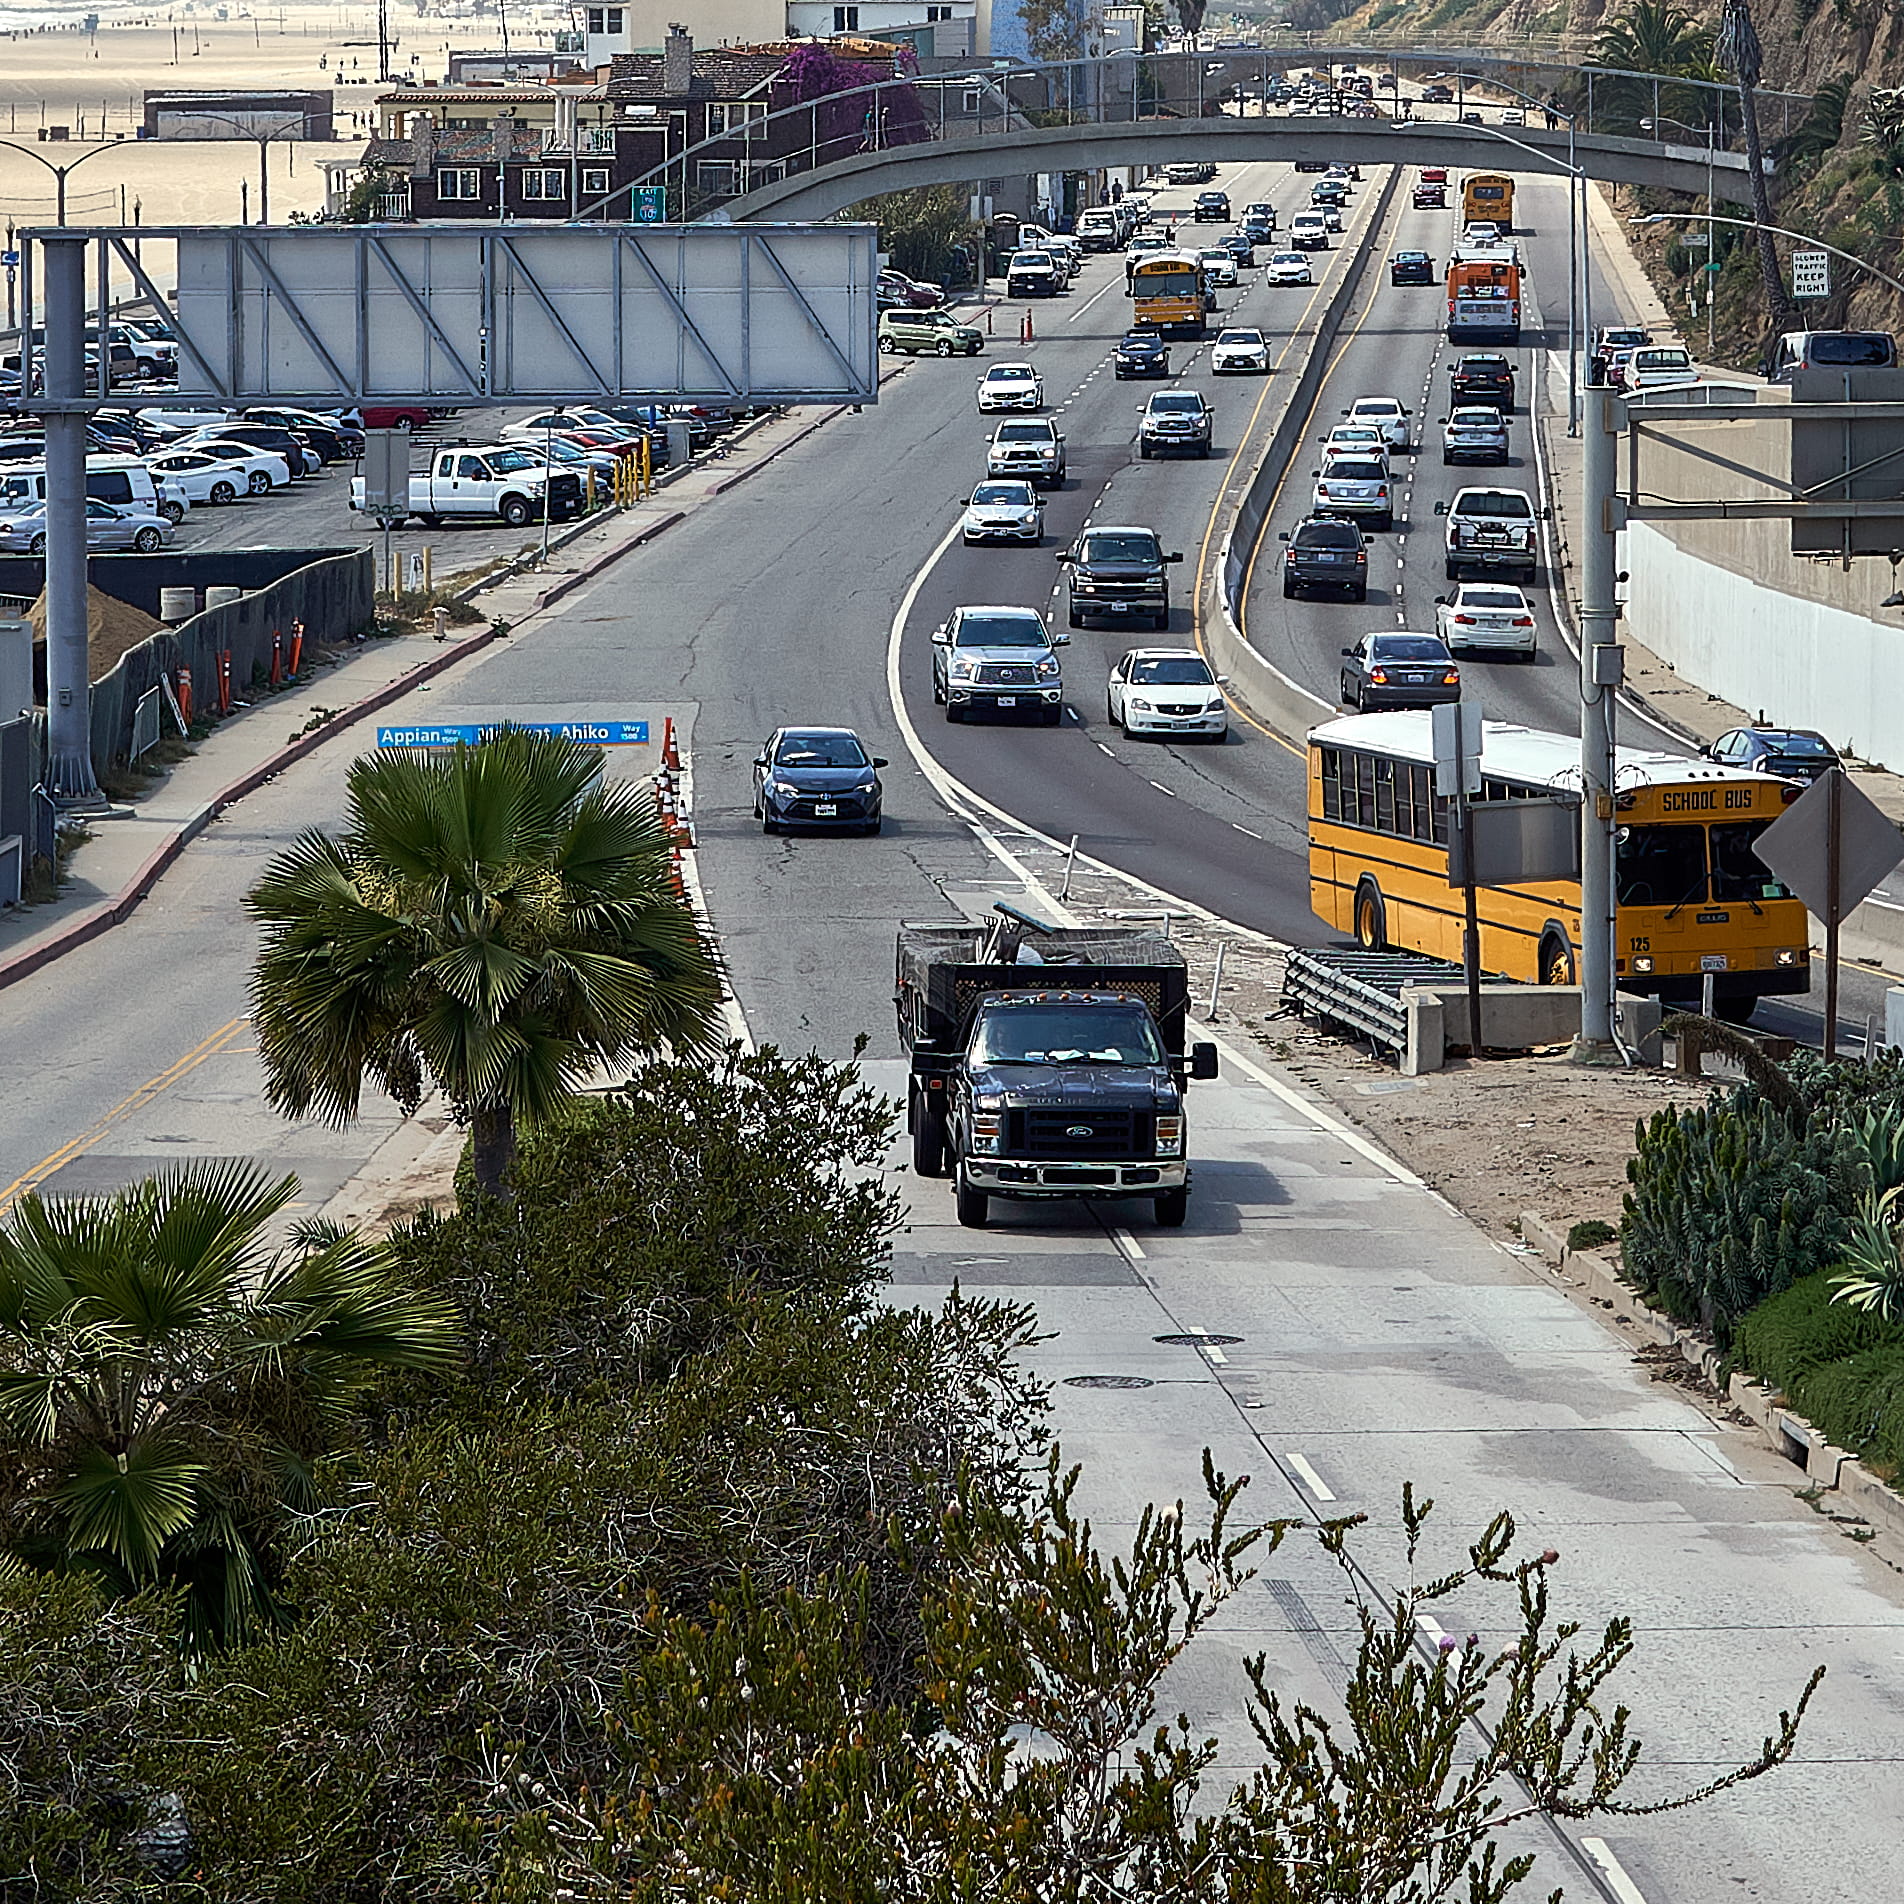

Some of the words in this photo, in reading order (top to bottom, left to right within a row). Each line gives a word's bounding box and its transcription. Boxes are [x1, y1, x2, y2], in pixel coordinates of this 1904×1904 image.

[1796, 272, 1825, 281] KEEP
[1796, 283, 1825, 293] RIGHT
[381, 727, 440, 746] Appian
[560, 724, 609, 740] Ahiko
[622, 724, 641, 733] Way
[1663, 789, 1717, 812] SCHOOL
[1724, 789, 1752, 809] BUS
[1630, 936, 1650, 952] 125
